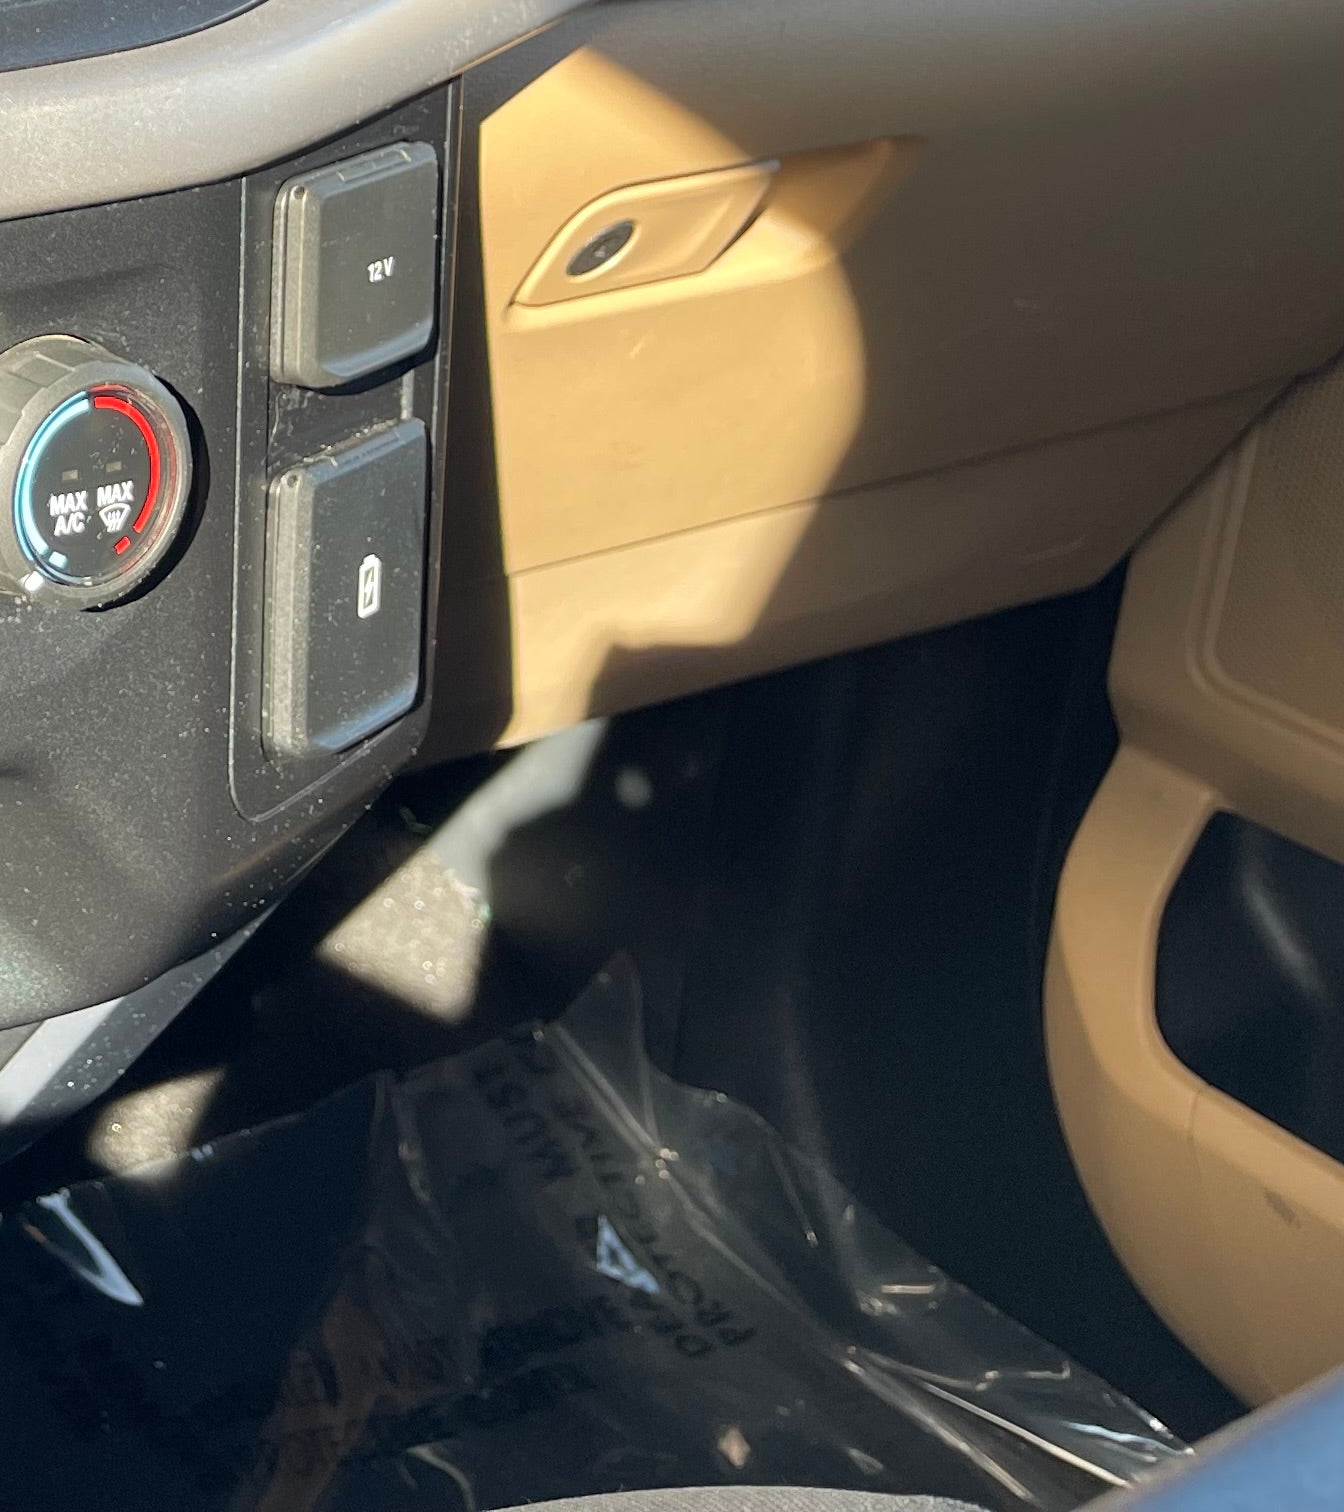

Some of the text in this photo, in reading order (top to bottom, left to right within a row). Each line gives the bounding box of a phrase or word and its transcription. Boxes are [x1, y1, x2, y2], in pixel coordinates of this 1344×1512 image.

[367, 256, 394, 283] 12V
[49, 489, 88, 516] MAX
[96, 479, 134, 505] MAX
[53, 510, 86, 537] A/C
